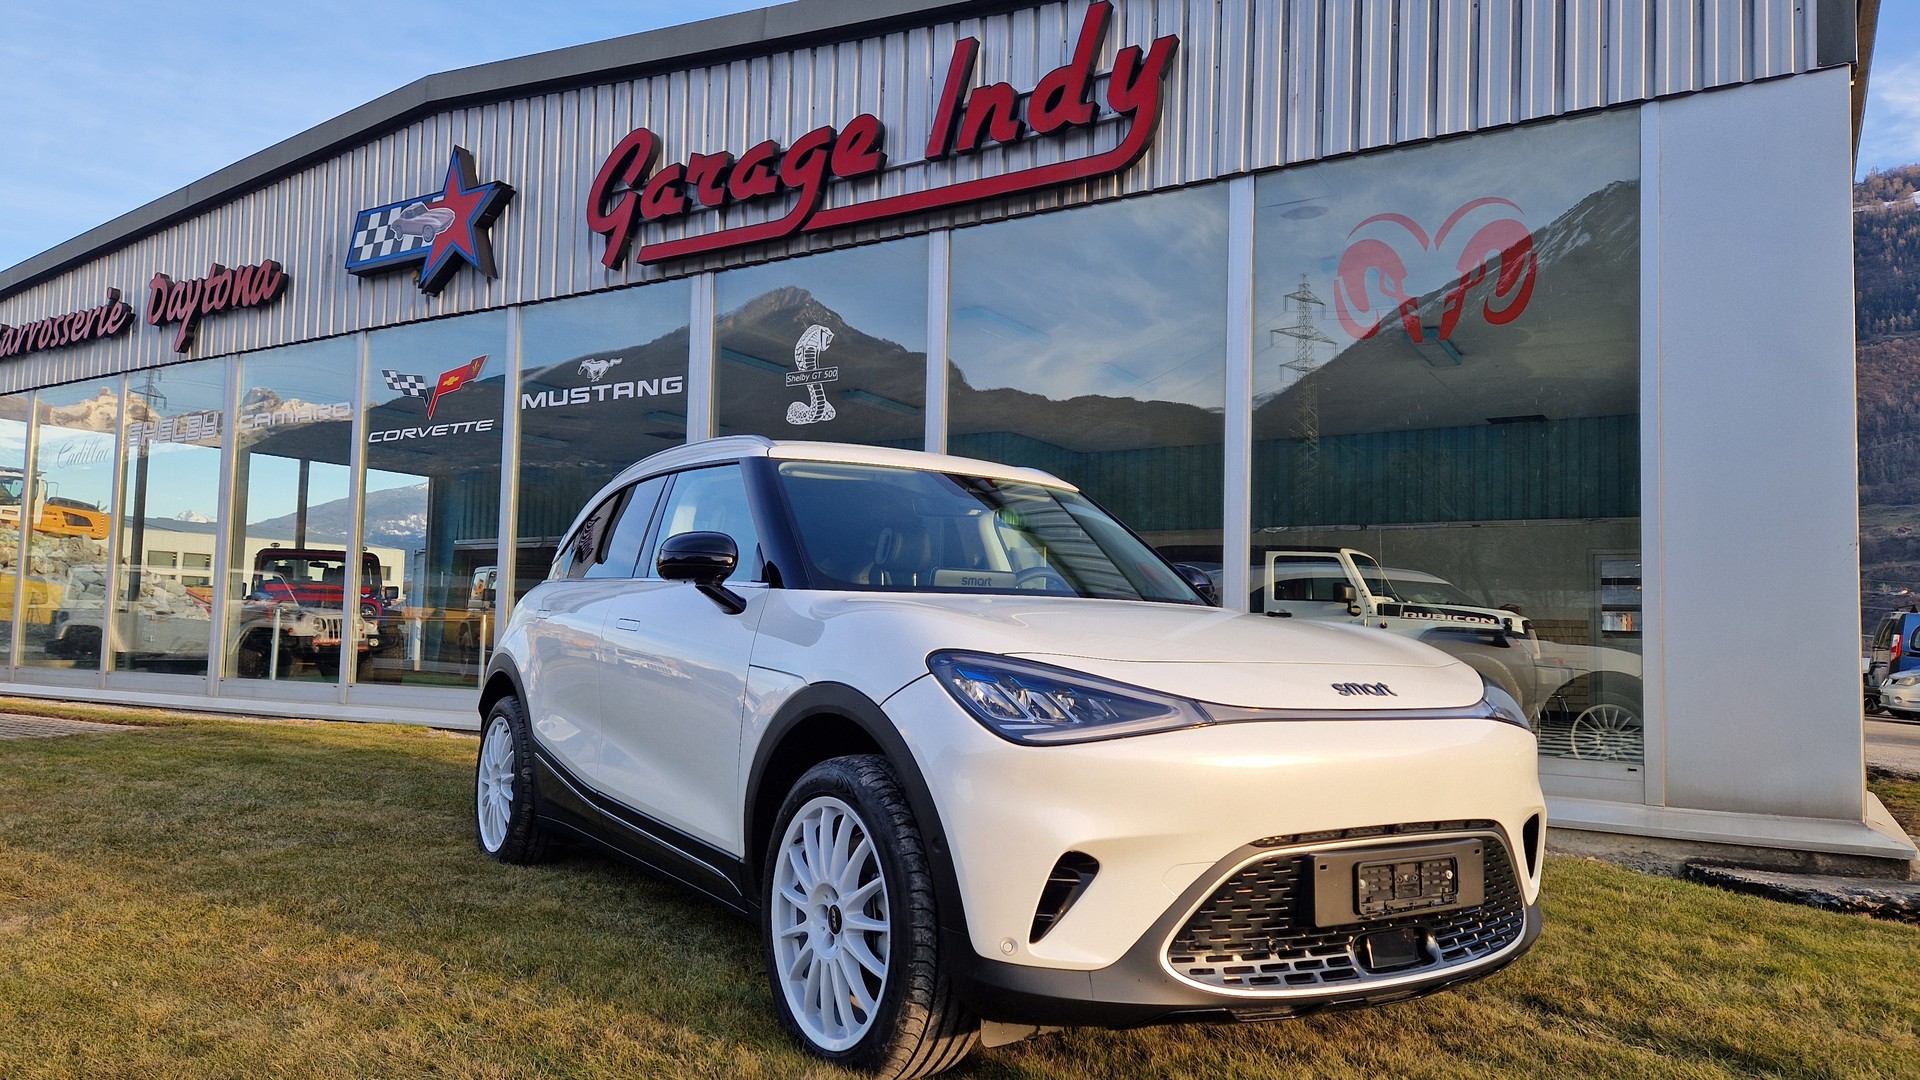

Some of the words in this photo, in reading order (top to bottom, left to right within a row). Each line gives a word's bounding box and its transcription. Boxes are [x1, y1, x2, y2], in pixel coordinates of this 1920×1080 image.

[586, 113, 888, 270] Garage
[924, 1, 1180, 180] Indy
[0, 286, 136, 358] arrosserie
[147, 258, 289, 353] Daytona
[787, 374, 810, 383] Shelby
[811, 371, 822, 380] GT
[824, 369, 837, 378] 500
[521, 375, 684, 410] MUSTANG
[127, 411, 220, 447] SHELBY
[239, 401, 351, 430] CAMARO
[367, 418, 495, 444] CORVETTE
[56, 436, 111, 470] Cadillac
[961, 576, 992, 587] smart
[1402, 611, 1496, 625] RUBICON
[1331, 681, 1398, 698] smart
